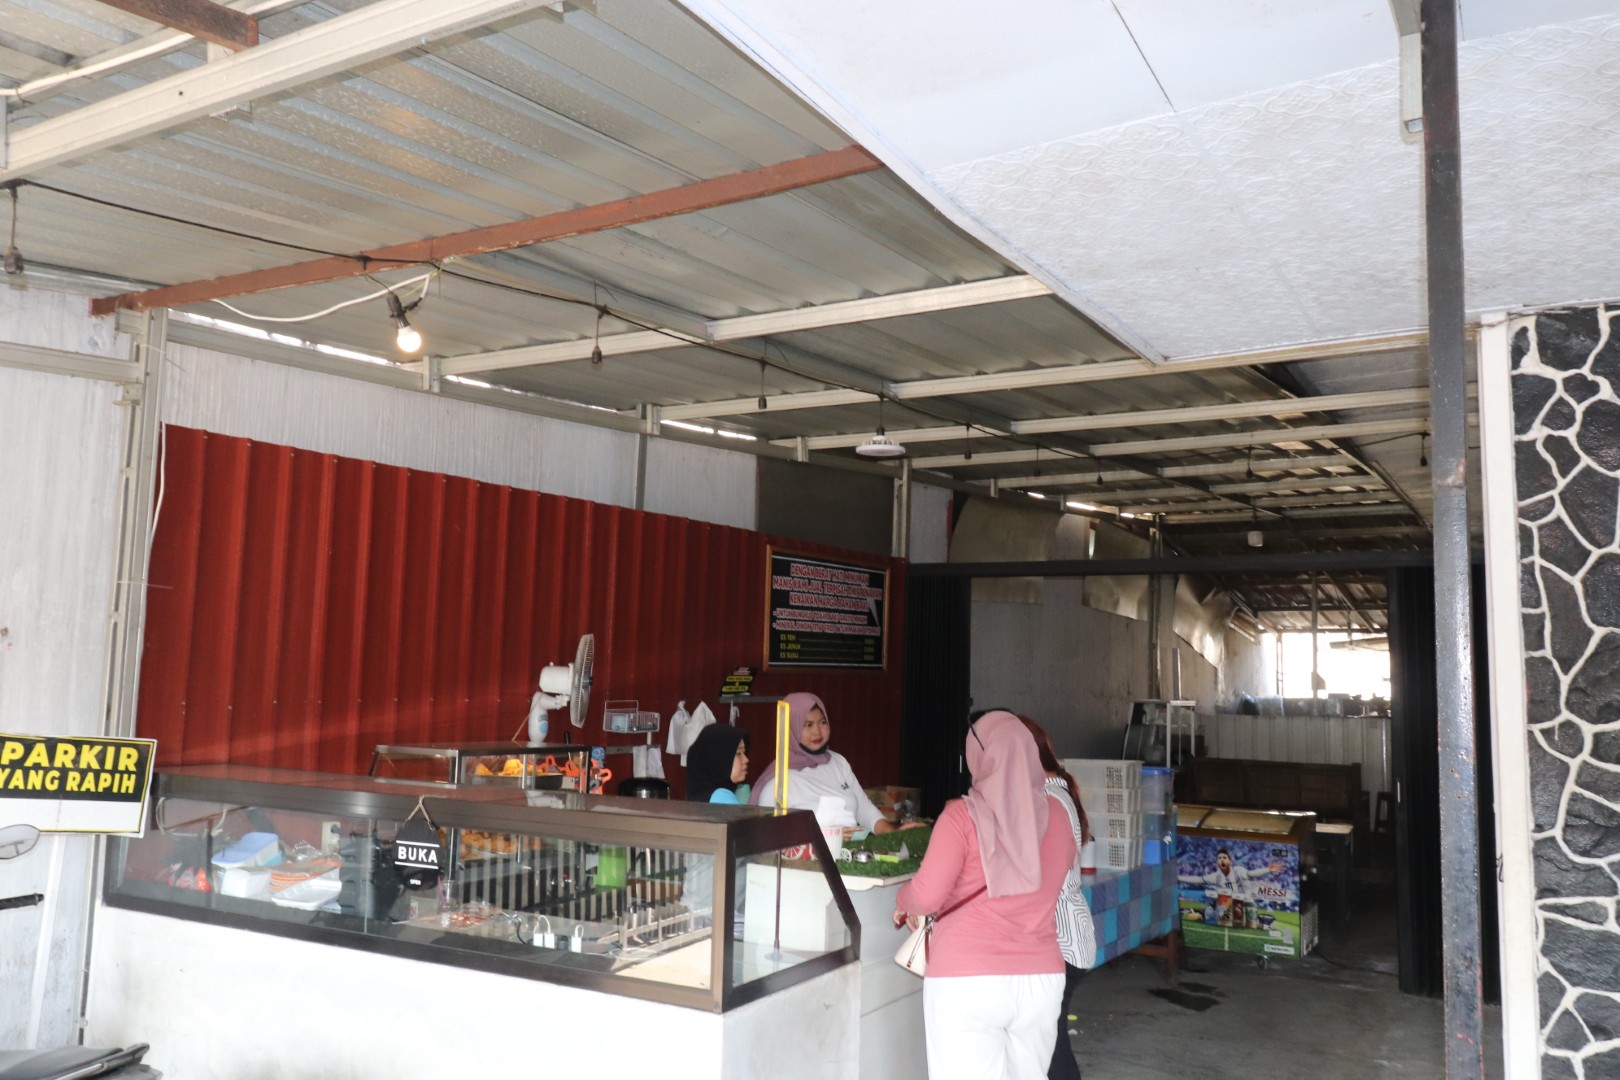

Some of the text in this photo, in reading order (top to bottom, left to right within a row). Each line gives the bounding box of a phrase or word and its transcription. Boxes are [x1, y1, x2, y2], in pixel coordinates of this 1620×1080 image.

[790, 564, 814, 578] DENGAN
[773, 577, 792, 590] MANIS
[1, 741, 139, 771] PARKIR
[66, 771, 136, 794] RAPIH
[398, 846, 438, 863] BUKA
[1257, 887, 1287, 897] MESSI
